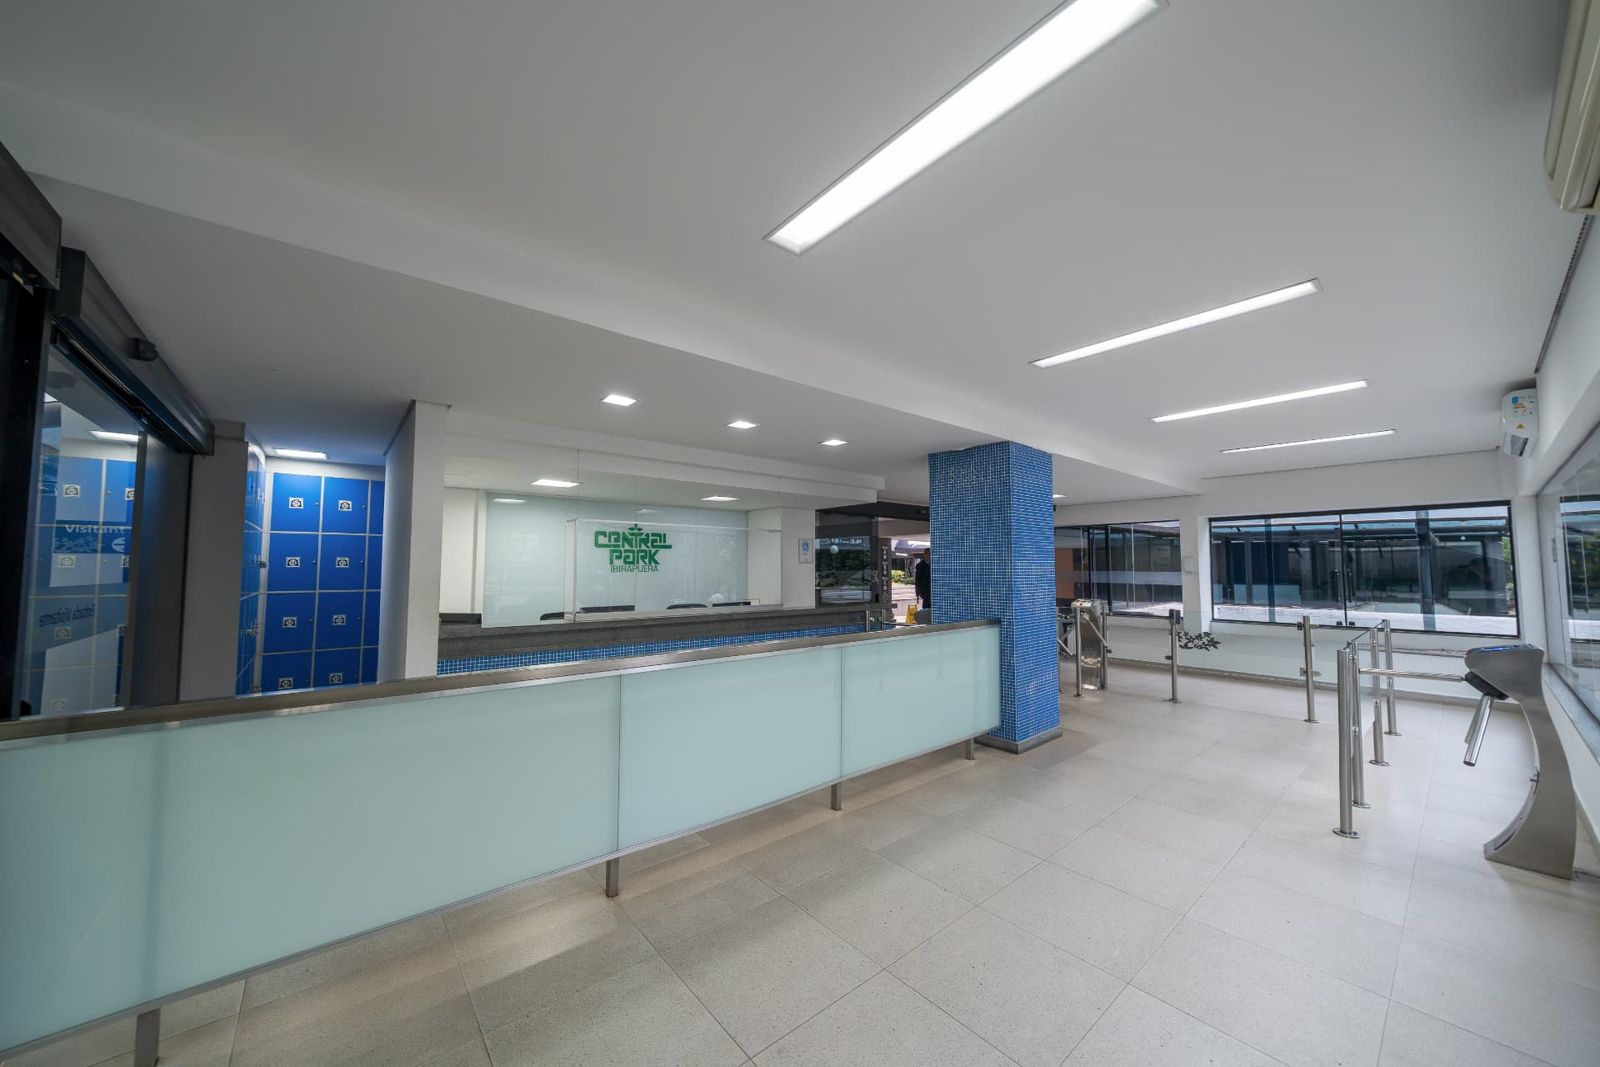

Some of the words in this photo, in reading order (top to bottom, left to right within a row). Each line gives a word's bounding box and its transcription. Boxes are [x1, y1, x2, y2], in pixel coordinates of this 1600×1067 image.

[594, 531, 673, 549] CENTRAL
[609, 549, 660, 565] PARK
[610, 565, 659, 573] IBIRAPUERA
